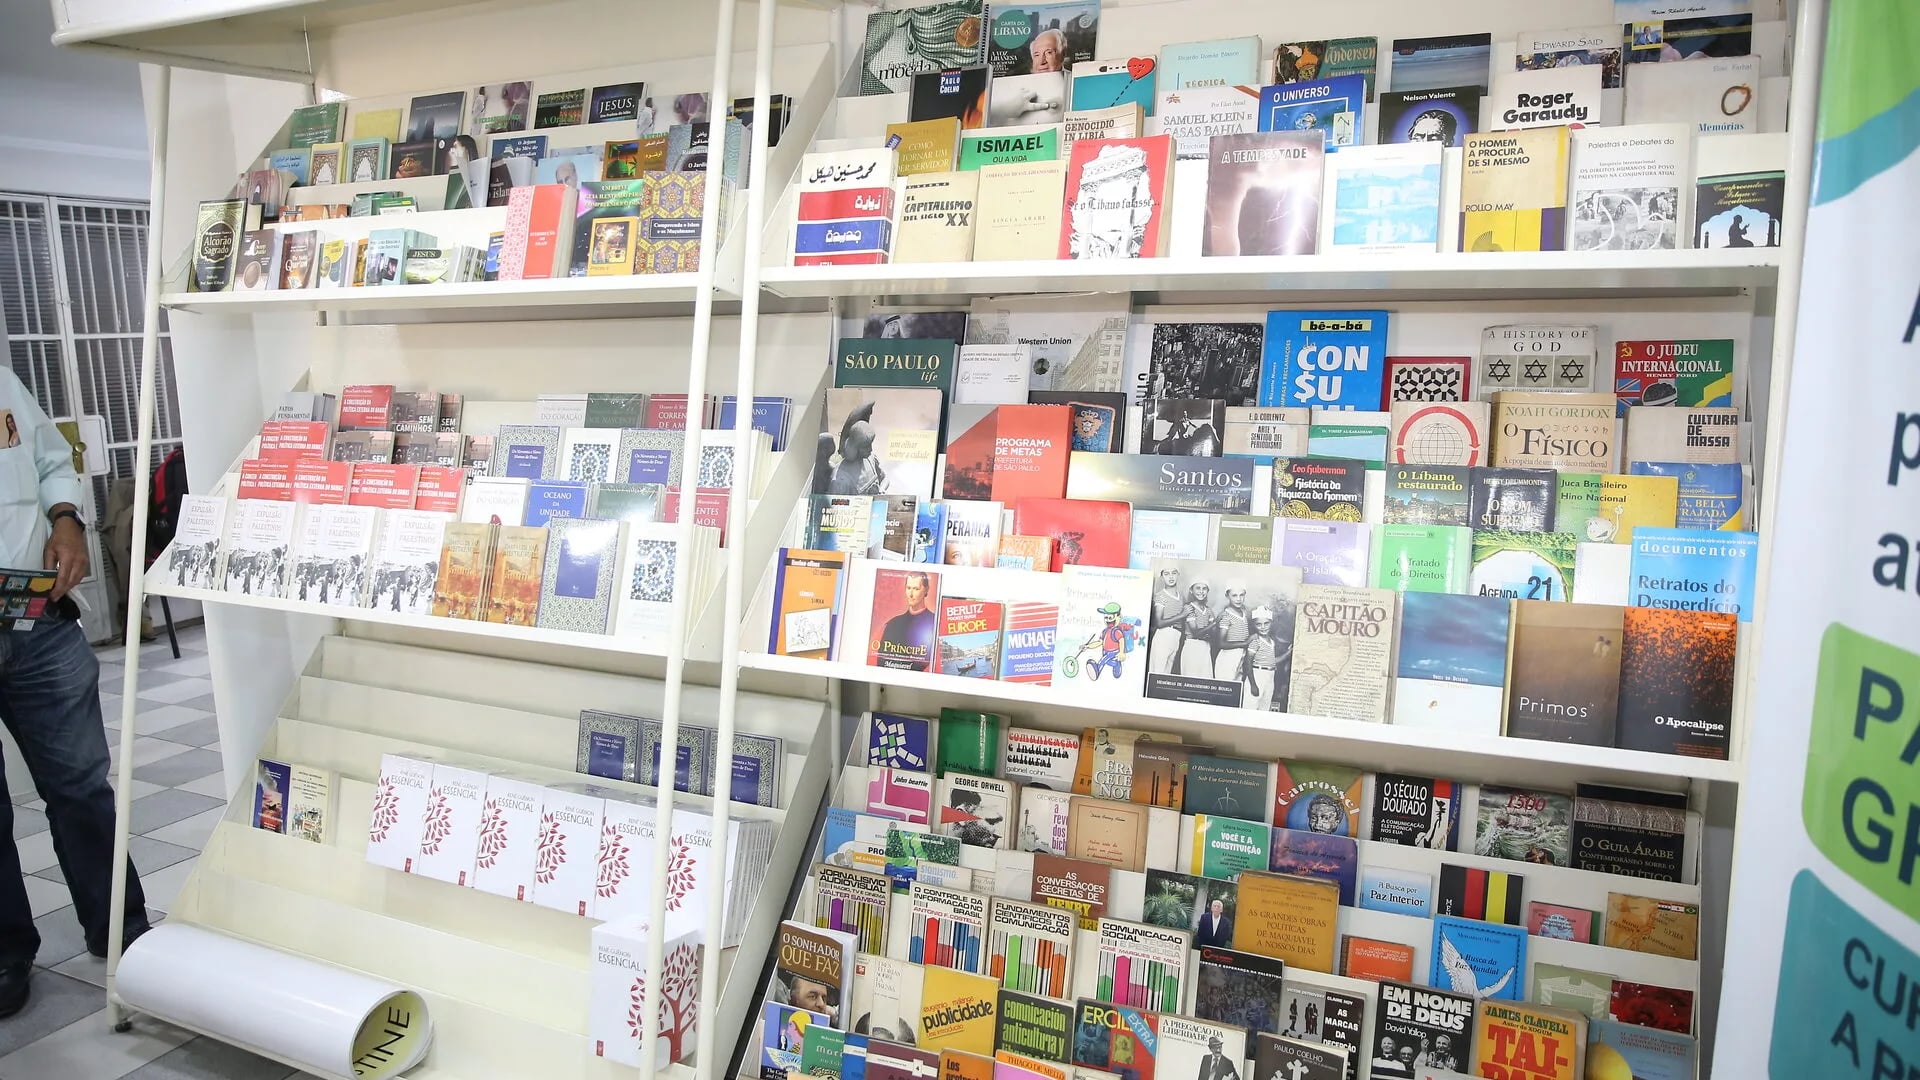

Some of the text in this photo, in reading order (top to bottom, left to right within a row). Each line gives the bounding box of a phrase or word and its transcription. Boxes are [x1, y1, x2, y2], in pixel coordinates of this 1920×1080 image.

[1534, 37, 1603, 50] EDWARD SAID
[941, 77, 960, 86] PAULO
[940, 84, 960, 94] COELHO
[1273, 86, 1330, 102] O UNIVERSO
[600, 98, 635, 113] JESUS.
[1518, 93, 1573, 108] Roger
[1163, 114, 1205, 125] SAMUEL
[1208, 111, 1245, 123] KLEIN
[1503, 105, 1588, 123] Garaudy
[1065, 120, 1115, 132] GENOCIDIO
[1698, 122, 1744, 132] Memórias
[976, 136, 1044, 154] ISMAEL
[1479, 139, 1517, 147] HOMEM
[1588, 141, 1620, 149] Palestras
[1630, 138, 1661, 146] Debates
[1478, 148, 1524, 156] PROCURA
[1493, 157, 1530, 165] MESMO
[904, 200, 972, 213] CAPITALISMO
[1465, 203, 1514, 212] ROLLO MAY
[945, 213, 969, 227] XX
[204, 236, 231, 246] Alcorão
[204, 246, 229, 256] Sagrado
[1309, 321, 1363, 331] bê-a-bá
[1018, 336, 1072, 346] Western Union
[1488, 329, 1589, 339] A HISTORY OF
[1513, 341, 1561, 352] GOD
[1646, 344, 1698, 357] O JUDEU
[844, 352, 940, 370] SÃO PAULO
[1297, 345, 1369, 371] CON
[1621, 359, 1722, 373] INTERNACIONAL
[921, 371, 938, 383] life
[1505, 407, 1610, 418] NOAH GORDON
[441, 418, 456, 426] SEM
[1688, 414, 1738, 426] CULTURA
[396, 424, 432, 432] CAMINHOS
[1687, 425, 1702, 436] DE
[996, 438, 1051, 448] PROGRAMA
[1504, 423, 1608, 458] O FÍSICO
[1687, 435, 1730, 447] MASSA
[995, 447, 1042, 456] DE METAS
[372, 455, 386, 463] SEM
[1159, 463, 1242, 487] Santos
[1292, 464, 1304, 474] Leo
[1398, 470, 1454, 481] O Líbano
[1295, 478, 1341, 490] História da
[1398, 479, 1463, 492] restaurado
[1560, 479, 1628, 489] Juca Brasileiro
[544, 492, 571, 500] OCEANO
[1277, 488, 1310, 502] Riqueza
[1312, 489, 1323, 500] do
[1561, 492, 1627, 503] Hino Nacional
[540, 509, 570, 517] UNIDADE
[1152, 541, 1175, 550] Islam
[1640, 541, 1747, 558] documentos
[1409, 570, 1444, 579] Direitos
[1479, 576, 1552, 601] AGENDA 21
[1638, 575, 1736, 594] Retratos do
[946, 604, 984, 617] BERLITZ
[1303, 601, 1387, 622] CAPITÃO
[947, 620, 987, 634] EUROPE
[1307, 618, 1380, 638] MOURO
[871, 639, 928, 656] O PRÍNCIPE
[1519, 697, 1588, 718] Primos
[1654, 716, 1724, 732] O Apocalipse
[390, 775, 424, 789] ESSENCIAL
[955, 777, 1005, 792] GEORGE ORWELL
[443, 786, 477, 800] ESSENCIAL
[498, 798, 534, 812] ESSENCIAL
[1382, 797, 1427, 817] DOURADO
[555, 811, 594, 827] ESSENCIAL
[1212, 840, 1261, 855] CONSTITUIÇÃO
[820, 868, 887, 886] JORNALISMO
[1066, 872, 1077, 880] AS
[820, 875, 886, 893] AUDIOVISUAL
[818, 888, 886, 905] WALTER SAMPAIO
[1041, 884, 1099, 901] SECRETAS DE
[1370, 890, 1424, 906] Paz Interior
[954, 908, 982, 919] BRASIL
[996, 903, 1070, 923] FUNDAMENTOS
[1260, 911, 1327, 927] GRANDES OBRAS
[1102, 930, 1140, 942] SOCIAL
[783, 933, 840, 961] O SONHADOR
[598, 952, 641, 972] ESSENCIAL
[782, 944, 840, 979] QUE FAZ
[1383, 985, 1472, 1016] EM NOME
[922, 1000, 994, 1033] publicidade
[1337, 1009, 1347, 1017] AS
[1387, 1001, 1465, 1030] DE DEUS
[1324, 1017, 1359, 1031] MARCAS
[1485, 1006, 1569, 1035] JAMES CLAVELL
[1126, 1012, 1155, 1048] EXTRA
[1162, 1026, 1207, 1041] LIBERDADE
[1336, 1031, 1346, 1039] DA
[1274, 1044, 1323, 1062] PAULO COELHO
[1488, 1025, 1568, 1078] TAI-
[947, 1059, 960, 1071] Los
